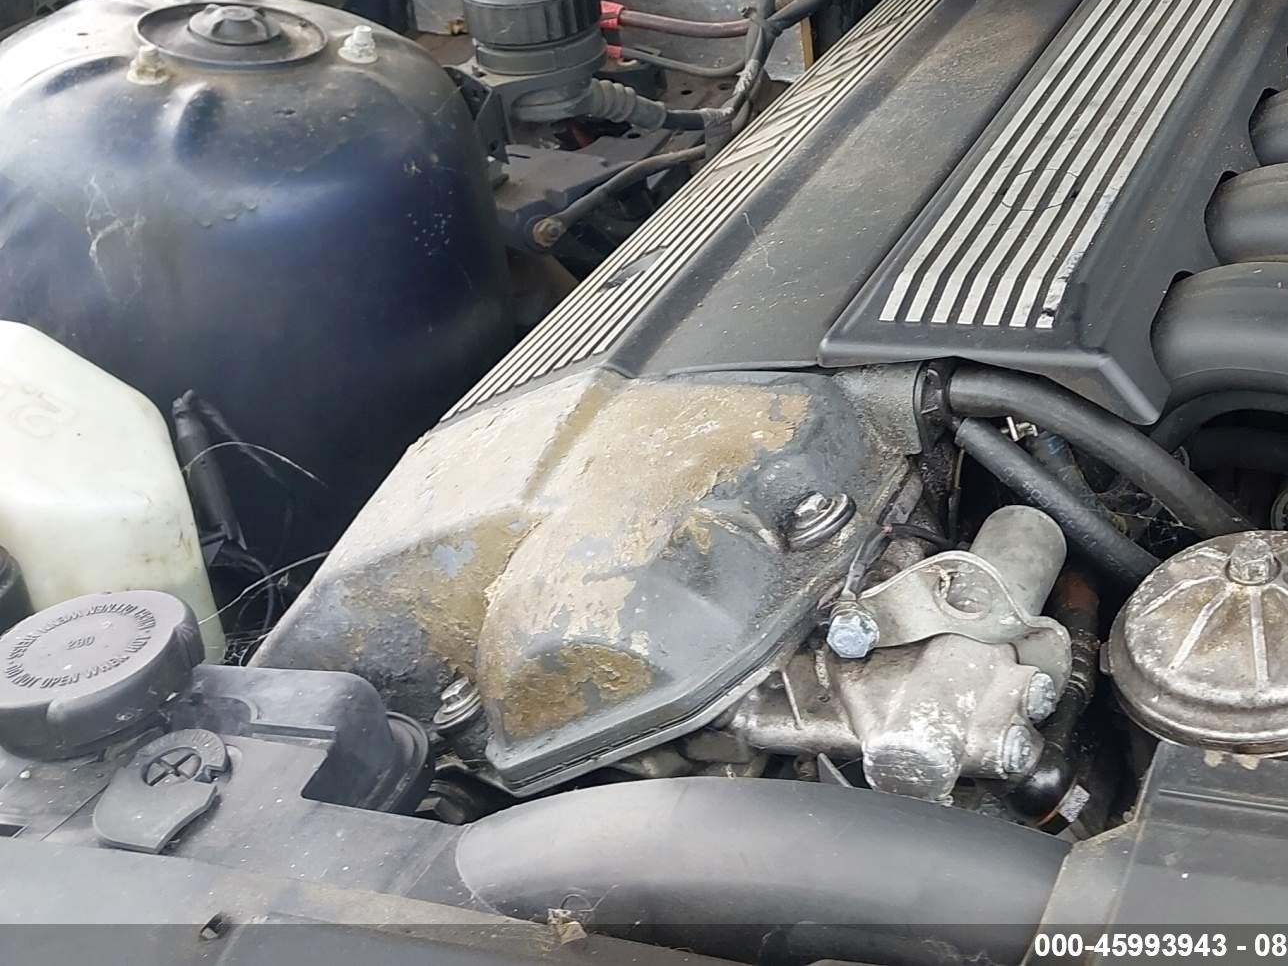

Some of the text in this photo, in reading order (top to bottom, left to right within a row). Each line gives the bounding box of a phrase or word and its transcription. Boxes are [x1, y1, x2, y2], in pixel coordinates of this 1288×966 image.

[11, 673, 41, 689] NOT
[40, 672, 80, 689] OPEN
[86, 655, 131, 680] WHEN
